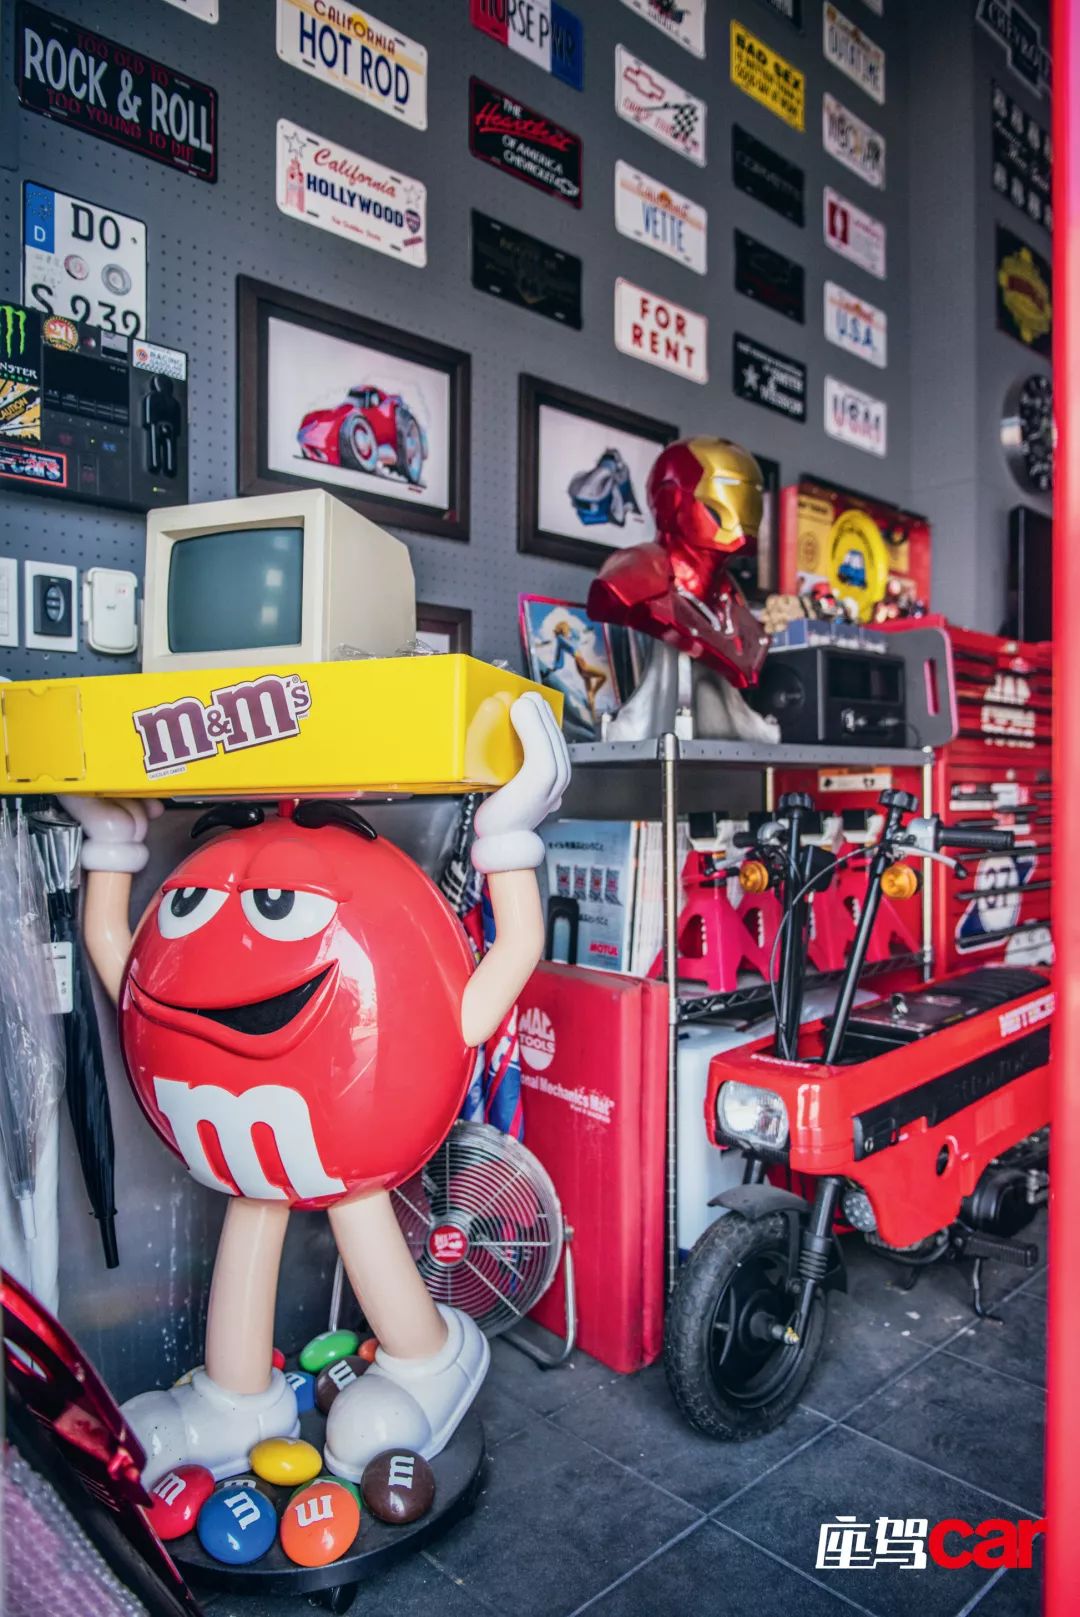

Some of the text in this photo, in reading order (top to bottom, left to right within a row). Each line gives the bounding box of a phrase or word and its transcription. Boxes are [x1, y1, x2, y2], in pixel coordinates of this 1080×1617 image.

[314, 0, 396, 55] CALIFORNIA
[77, 33, 169, 87] TOO OLD TO
[300, 11, 352, 76] HOT
[361, 45, 410, 106] ROD
[24, 27, 214, 154] ROCK & ROLL
[503, 98, 522, 118] THE
[47, 88, 196, 163] TOO YOUNG TO DIE
[313, 148, 397, 199] California
[306, 172, 404, 229] HOLLYWOOD
[34, 225, 47, 242] D
[71, 202, 121, 251] DO
[640, 297, 687, 338] FOR
[631, 323, 695, 369] RENT
[519, 1007, 556, 1041] MAC
[519, 1033, 555, 1050] TOOLS
[153, 1472, 187, 1506] m
[388, 1455, 415, 1489] m
[224, 1491, 261, 1531] m
[294, 1494, 334, 1528] m
